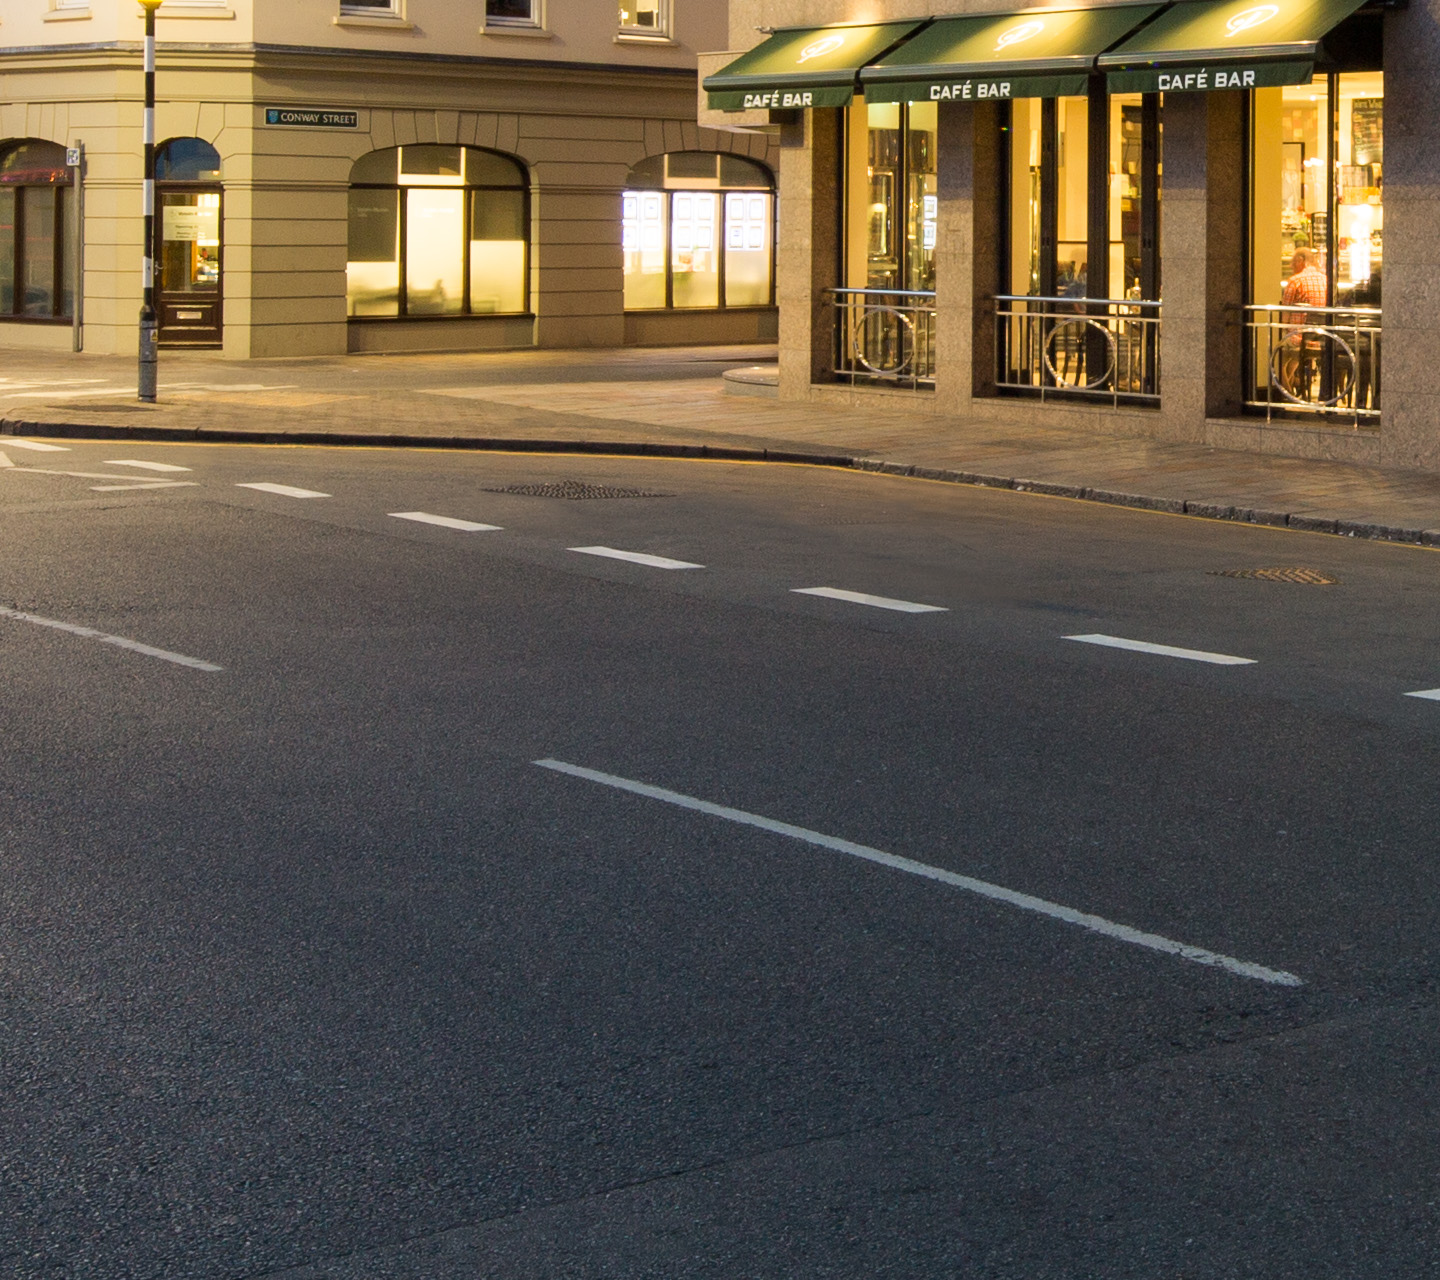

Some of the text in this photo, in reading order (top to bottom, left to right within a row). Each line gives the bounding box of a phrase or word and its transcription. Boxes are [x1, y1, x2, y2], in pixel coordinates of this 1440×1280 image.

[1158, 68, 1256, 90] CAFÉ BAR
[743, 90, 812, 108] CAFÉ BAR
[929, 80, 1011, 100] CAFÉ BAR
[280, 112, 356, 124] CONWAY STREET
